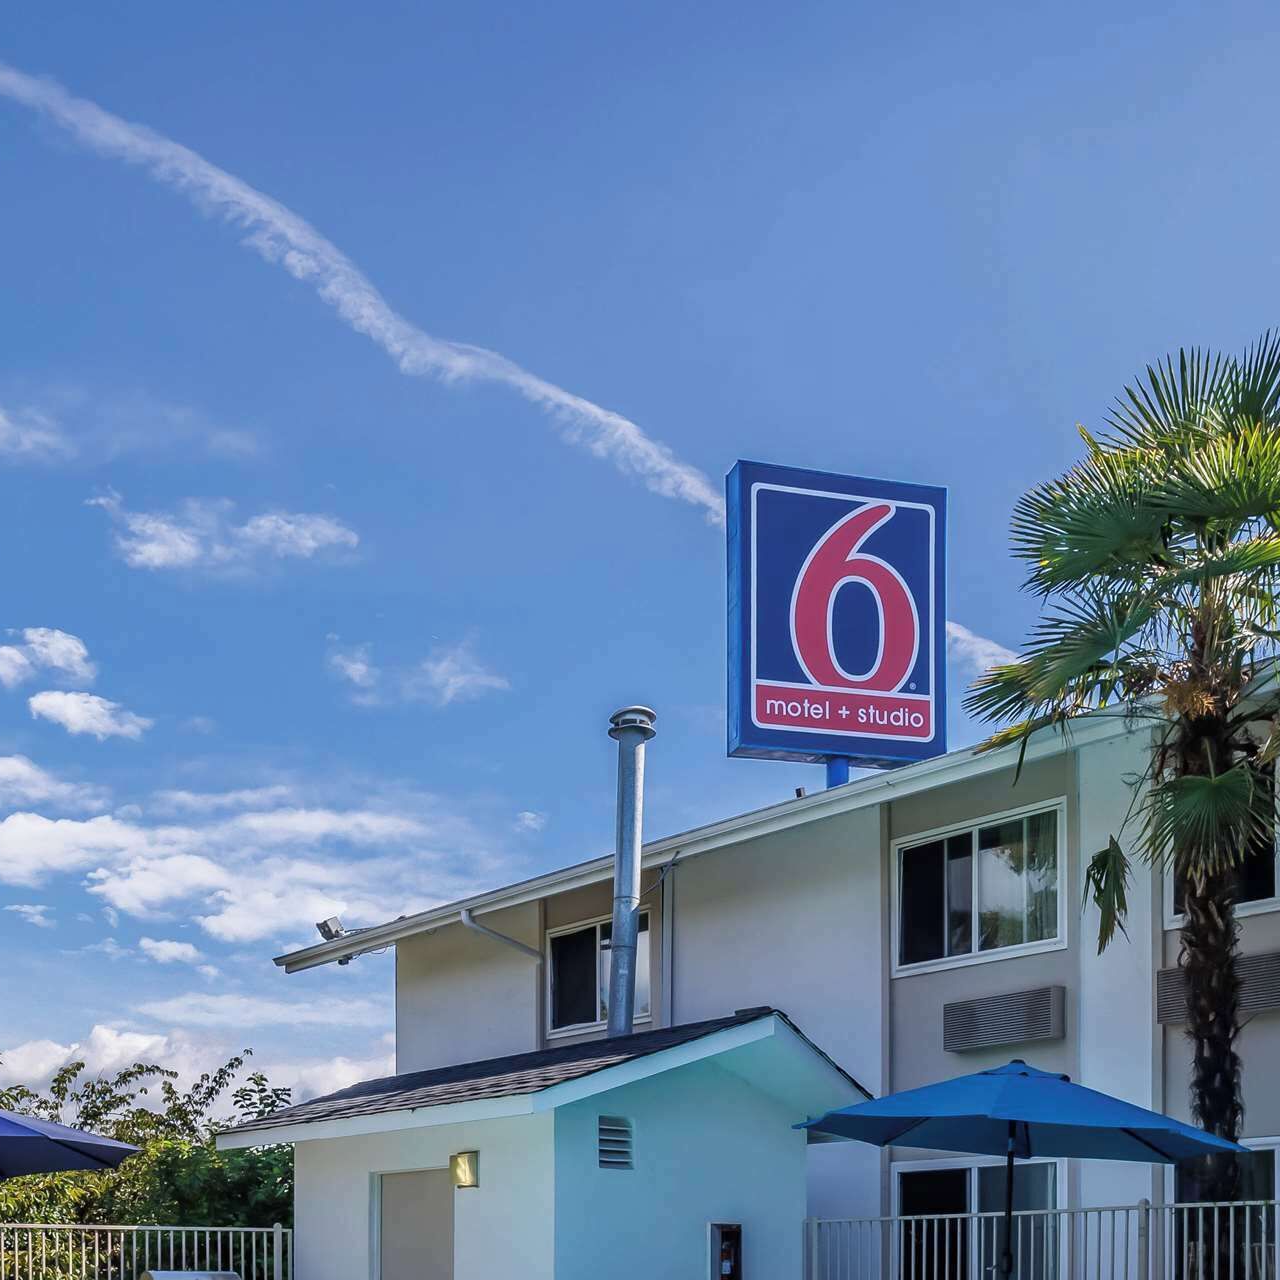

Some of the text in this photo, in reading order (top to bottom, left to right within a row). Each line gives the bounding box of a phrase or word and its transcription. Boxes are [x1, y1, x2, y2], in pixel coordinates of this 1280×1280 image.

[789, 501, 920, 694] 6
[766, 698, 830, 720] motel
[858, 705, 924, 728] studio
